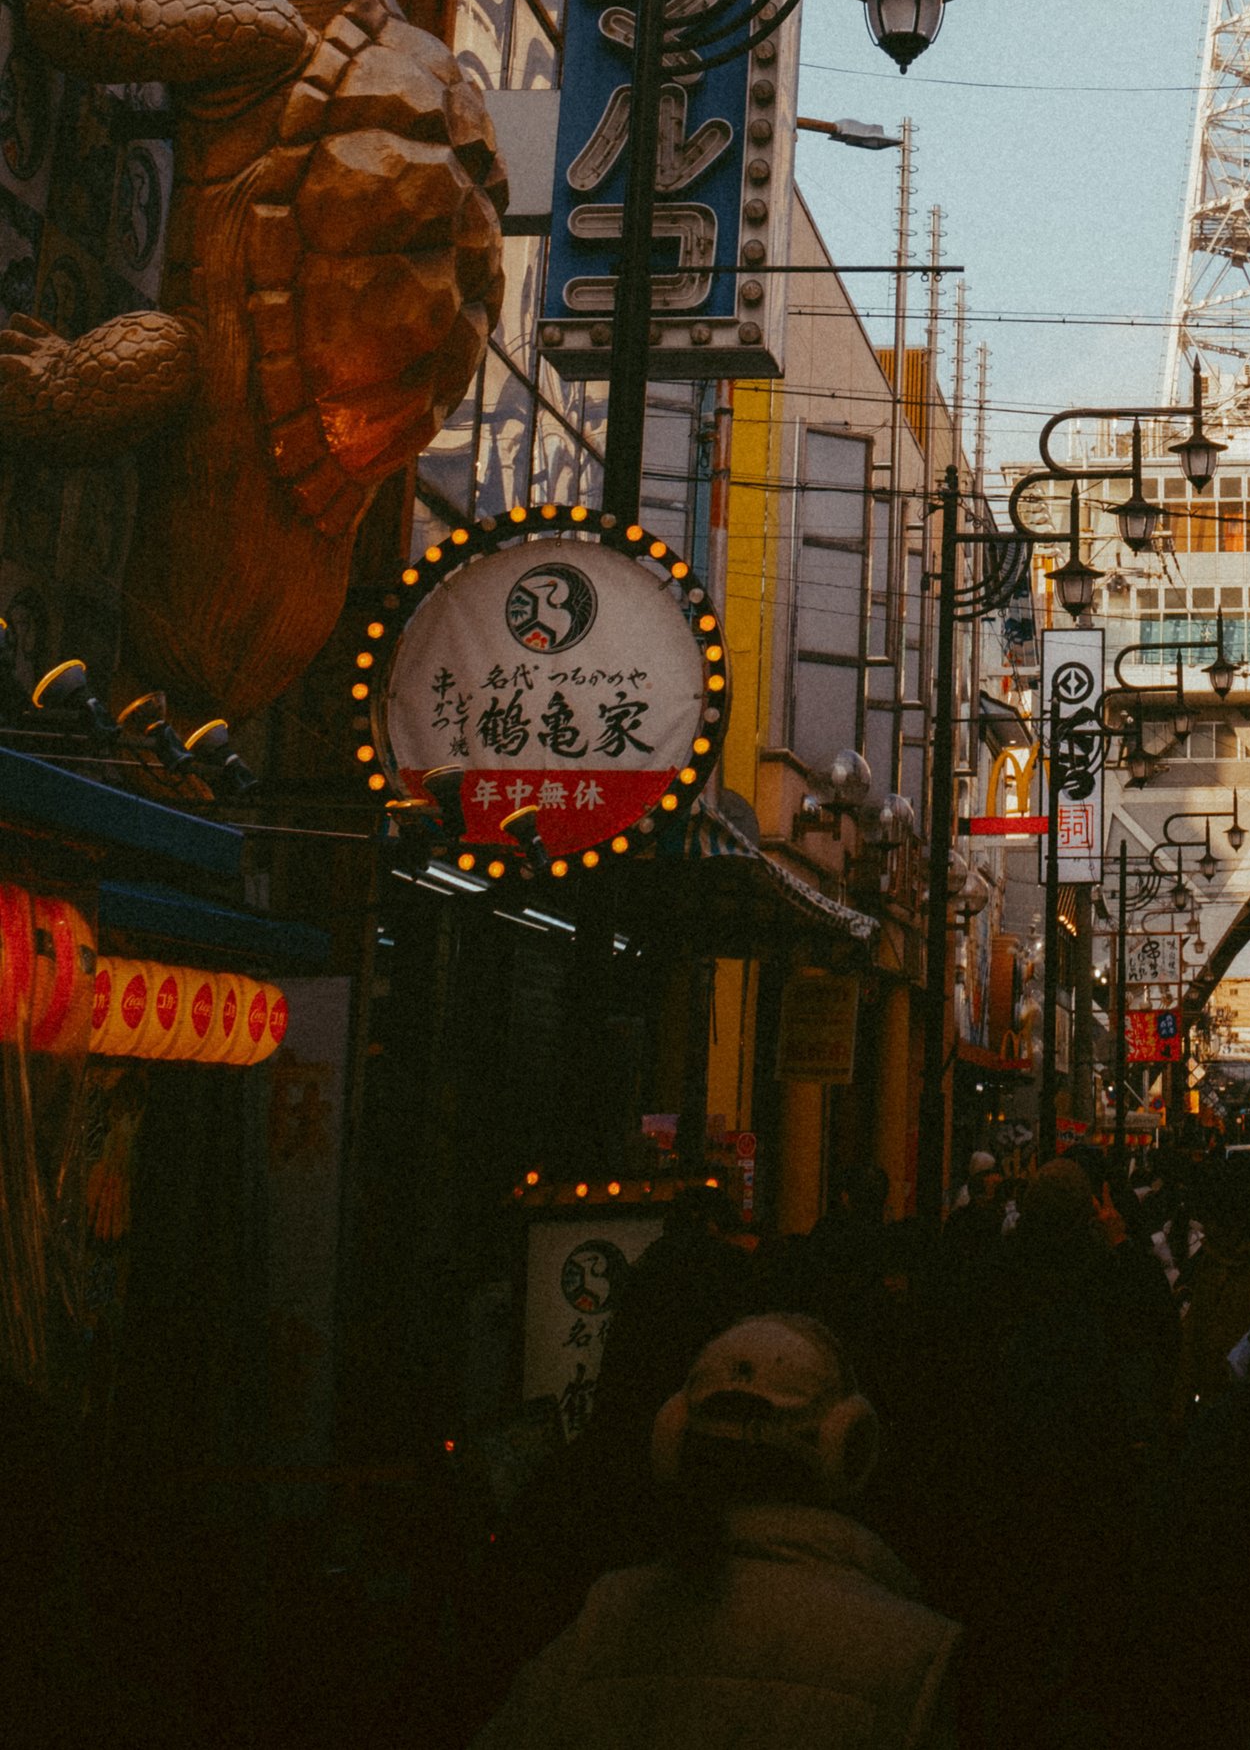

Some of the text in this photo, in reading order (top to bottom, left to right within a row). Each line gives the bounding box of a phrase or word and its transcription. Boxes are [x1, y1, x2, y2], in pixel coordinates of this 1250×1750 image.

[431, 668, 456, 732] 串かつ
[480, 663, 648, 690] 名代 つるかめや
[448, 692, 474, 758] どて焼
[474, 689, 656, 759] 鶴亀家
[470, 777, 606, 811] 年中無休
